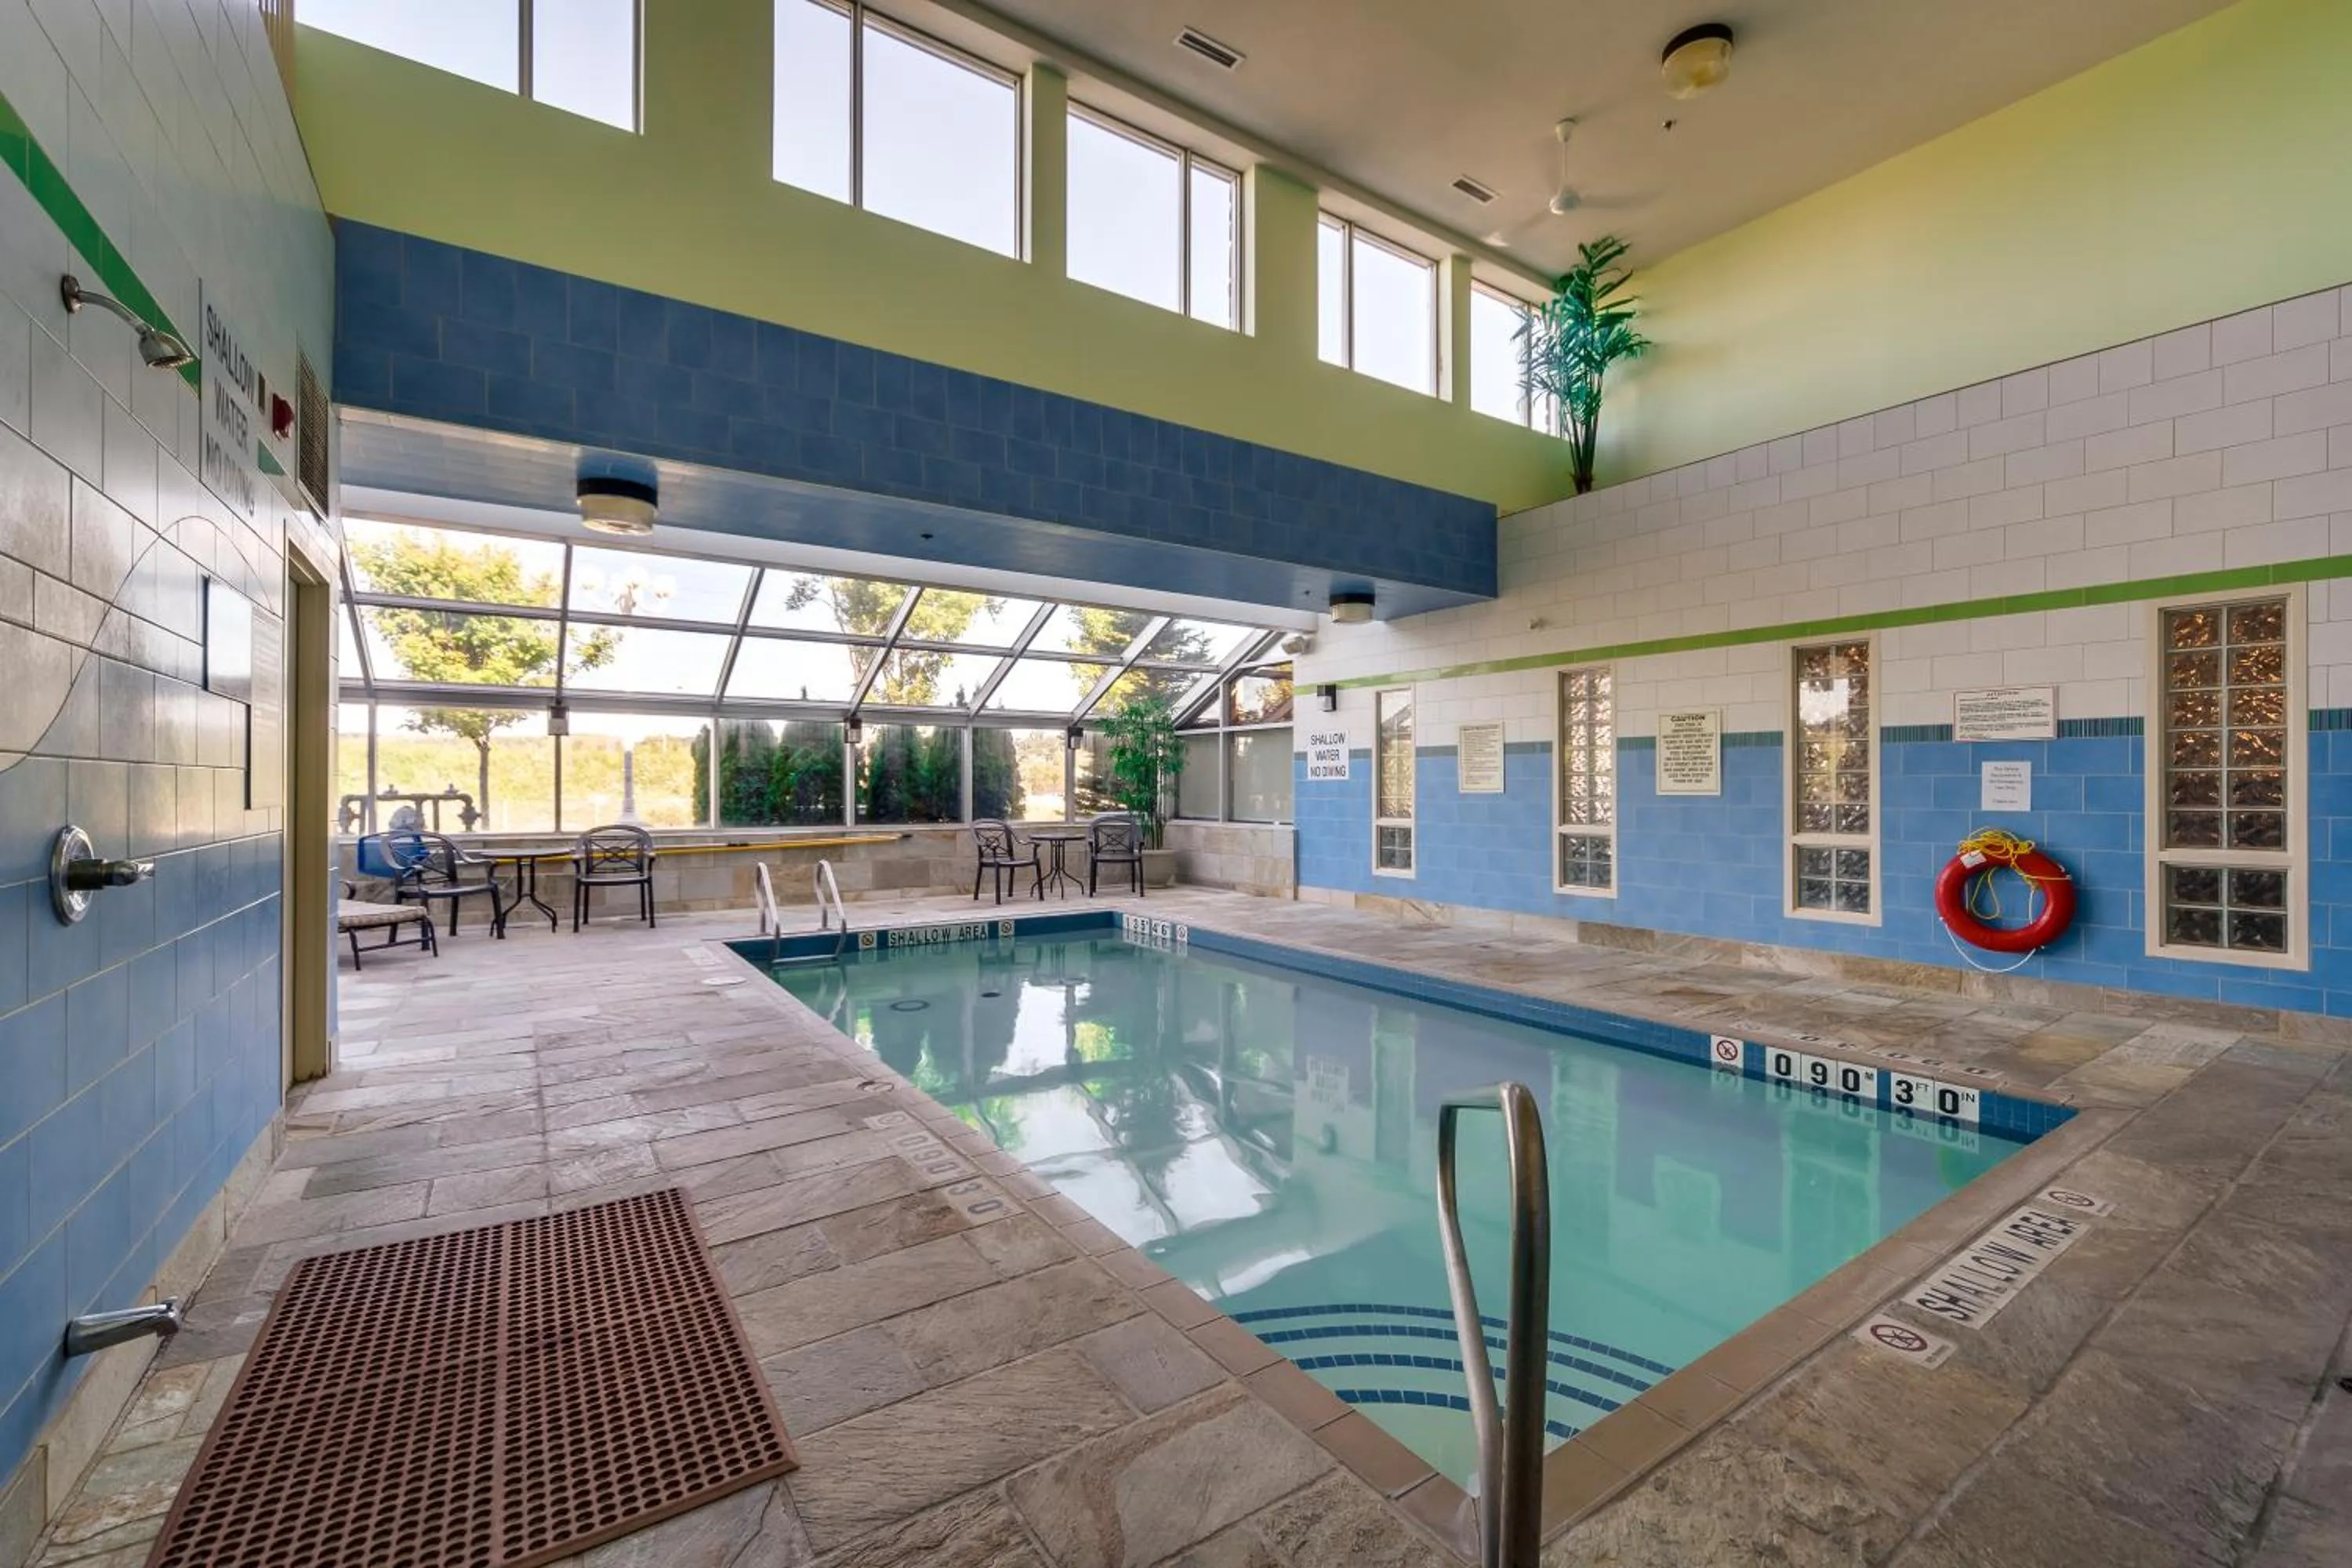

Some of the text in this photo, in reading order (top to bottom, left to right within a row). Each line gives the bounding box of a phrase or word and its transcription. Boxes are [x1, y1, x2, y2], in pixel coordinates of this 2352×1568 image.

[206, 303, 256, 405] SHALLOW
[213, 376, 249, 456] WATER
[205, 432, 223, 483] NO
[1310, 733, 1346, 746] SHALLOW
[1315, 750, 1340, 761] WATER
[1310, 765, 1346, 778] NO DIVING
[889, 923, 989, 946] SHALLOW AREA
[1917, 1210, 2081, 1322] SHALLOW AREA
